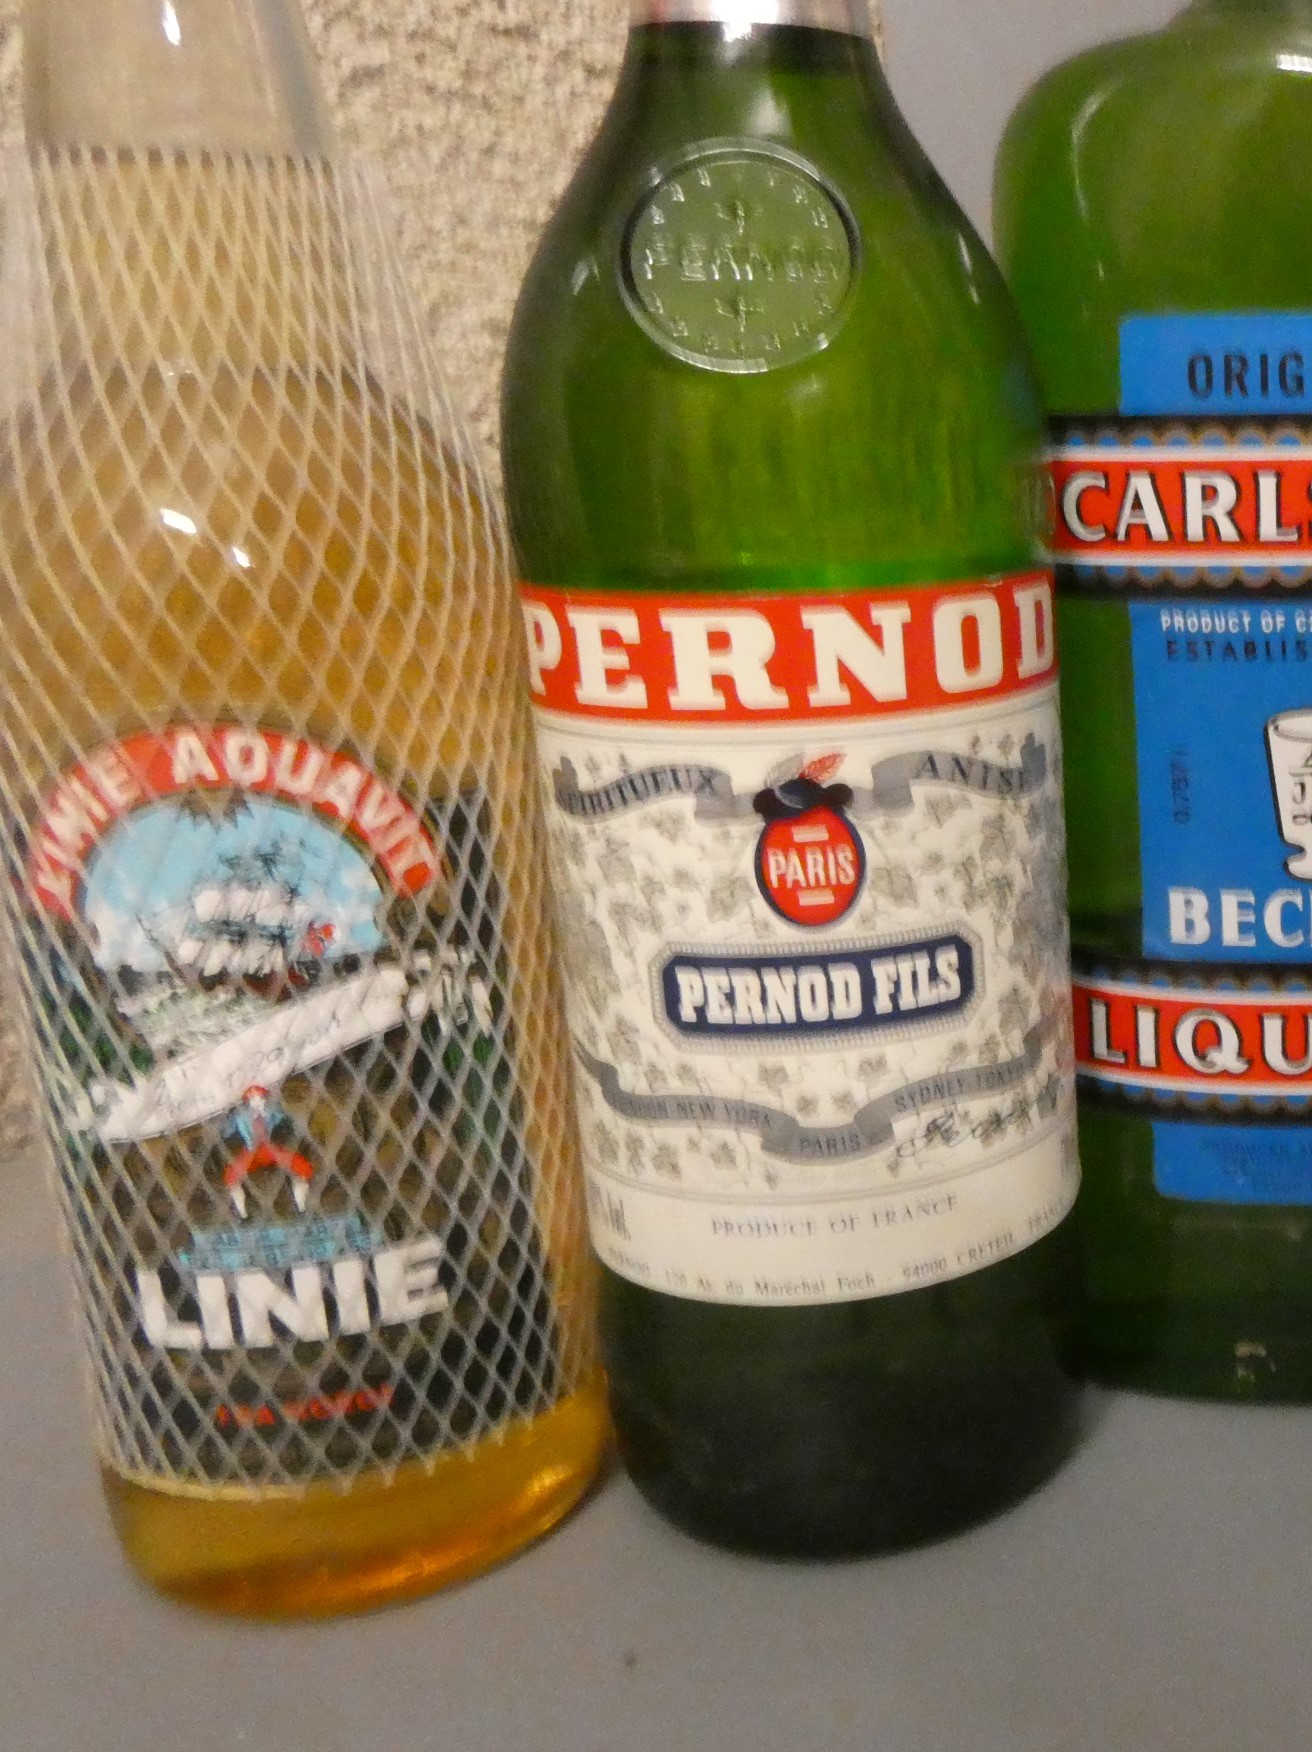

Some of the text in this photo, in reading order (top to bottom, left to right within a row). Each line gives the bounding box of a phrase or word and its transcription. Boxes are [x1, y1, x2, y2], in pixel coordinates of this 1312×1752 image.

[1160, 606, 1252, 634] PRODUCT
[1261, 606, 1286, 634] OF
[522, 580, 1056, 711] PERNOD
[170, 725, 442, 897] AQUAVIT
[767, 843, 857, 889] PARIS
[674, 943, 962, 1025] PERNOD FILS
[893, 1077, 965, 1113] SYDNEY
[799, 1133, 862, 1156] PARIS
[710, 1194, 958, 1239] PRODUCT OF FRANCE
[136, 1237, 450, 1349] LINIE
